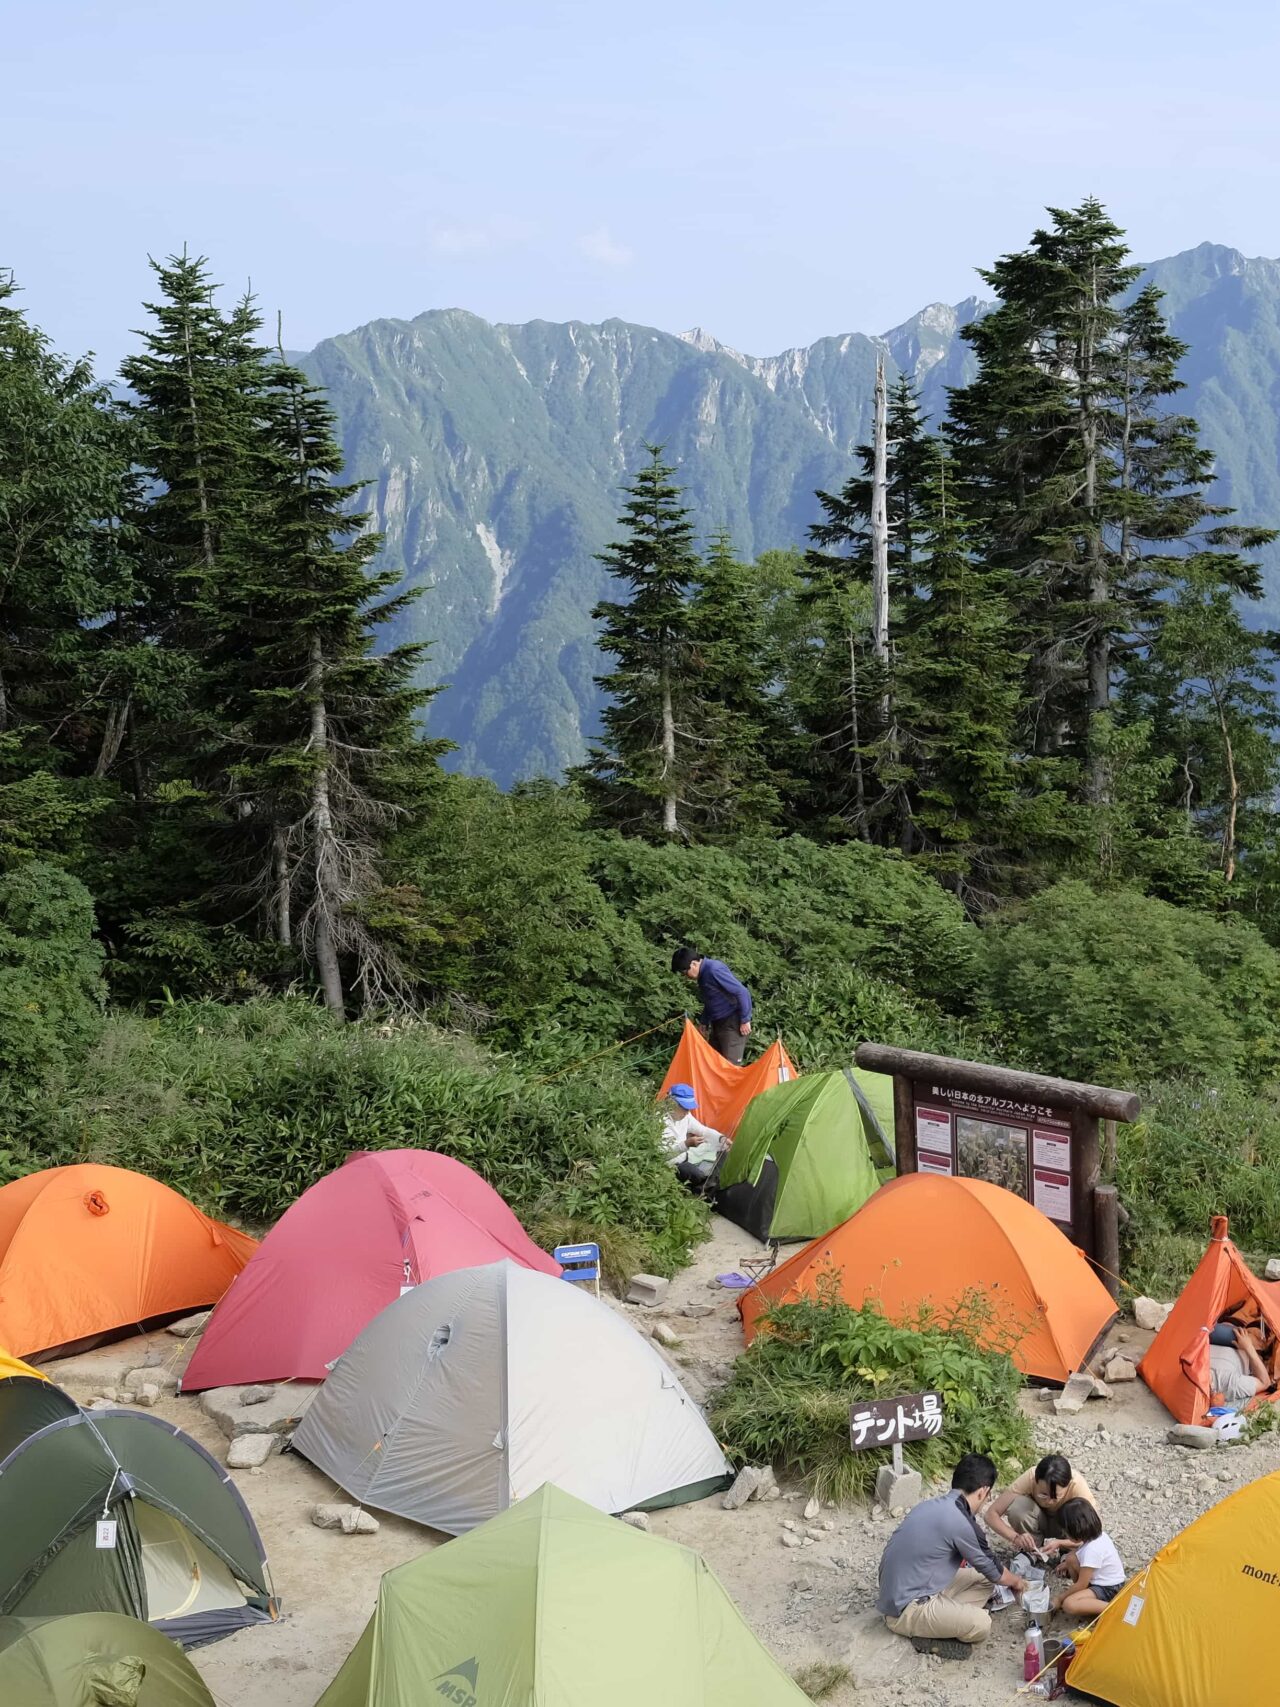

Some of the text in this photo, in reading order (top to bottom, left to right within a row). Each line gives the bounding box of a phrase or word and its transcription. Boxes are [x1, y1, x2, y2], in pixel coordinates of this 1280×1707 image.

[932, 1086, 1053, 1117] 美しい日本の北アルプスへようこそ
[852, 1394, 942, 1445] テント場
